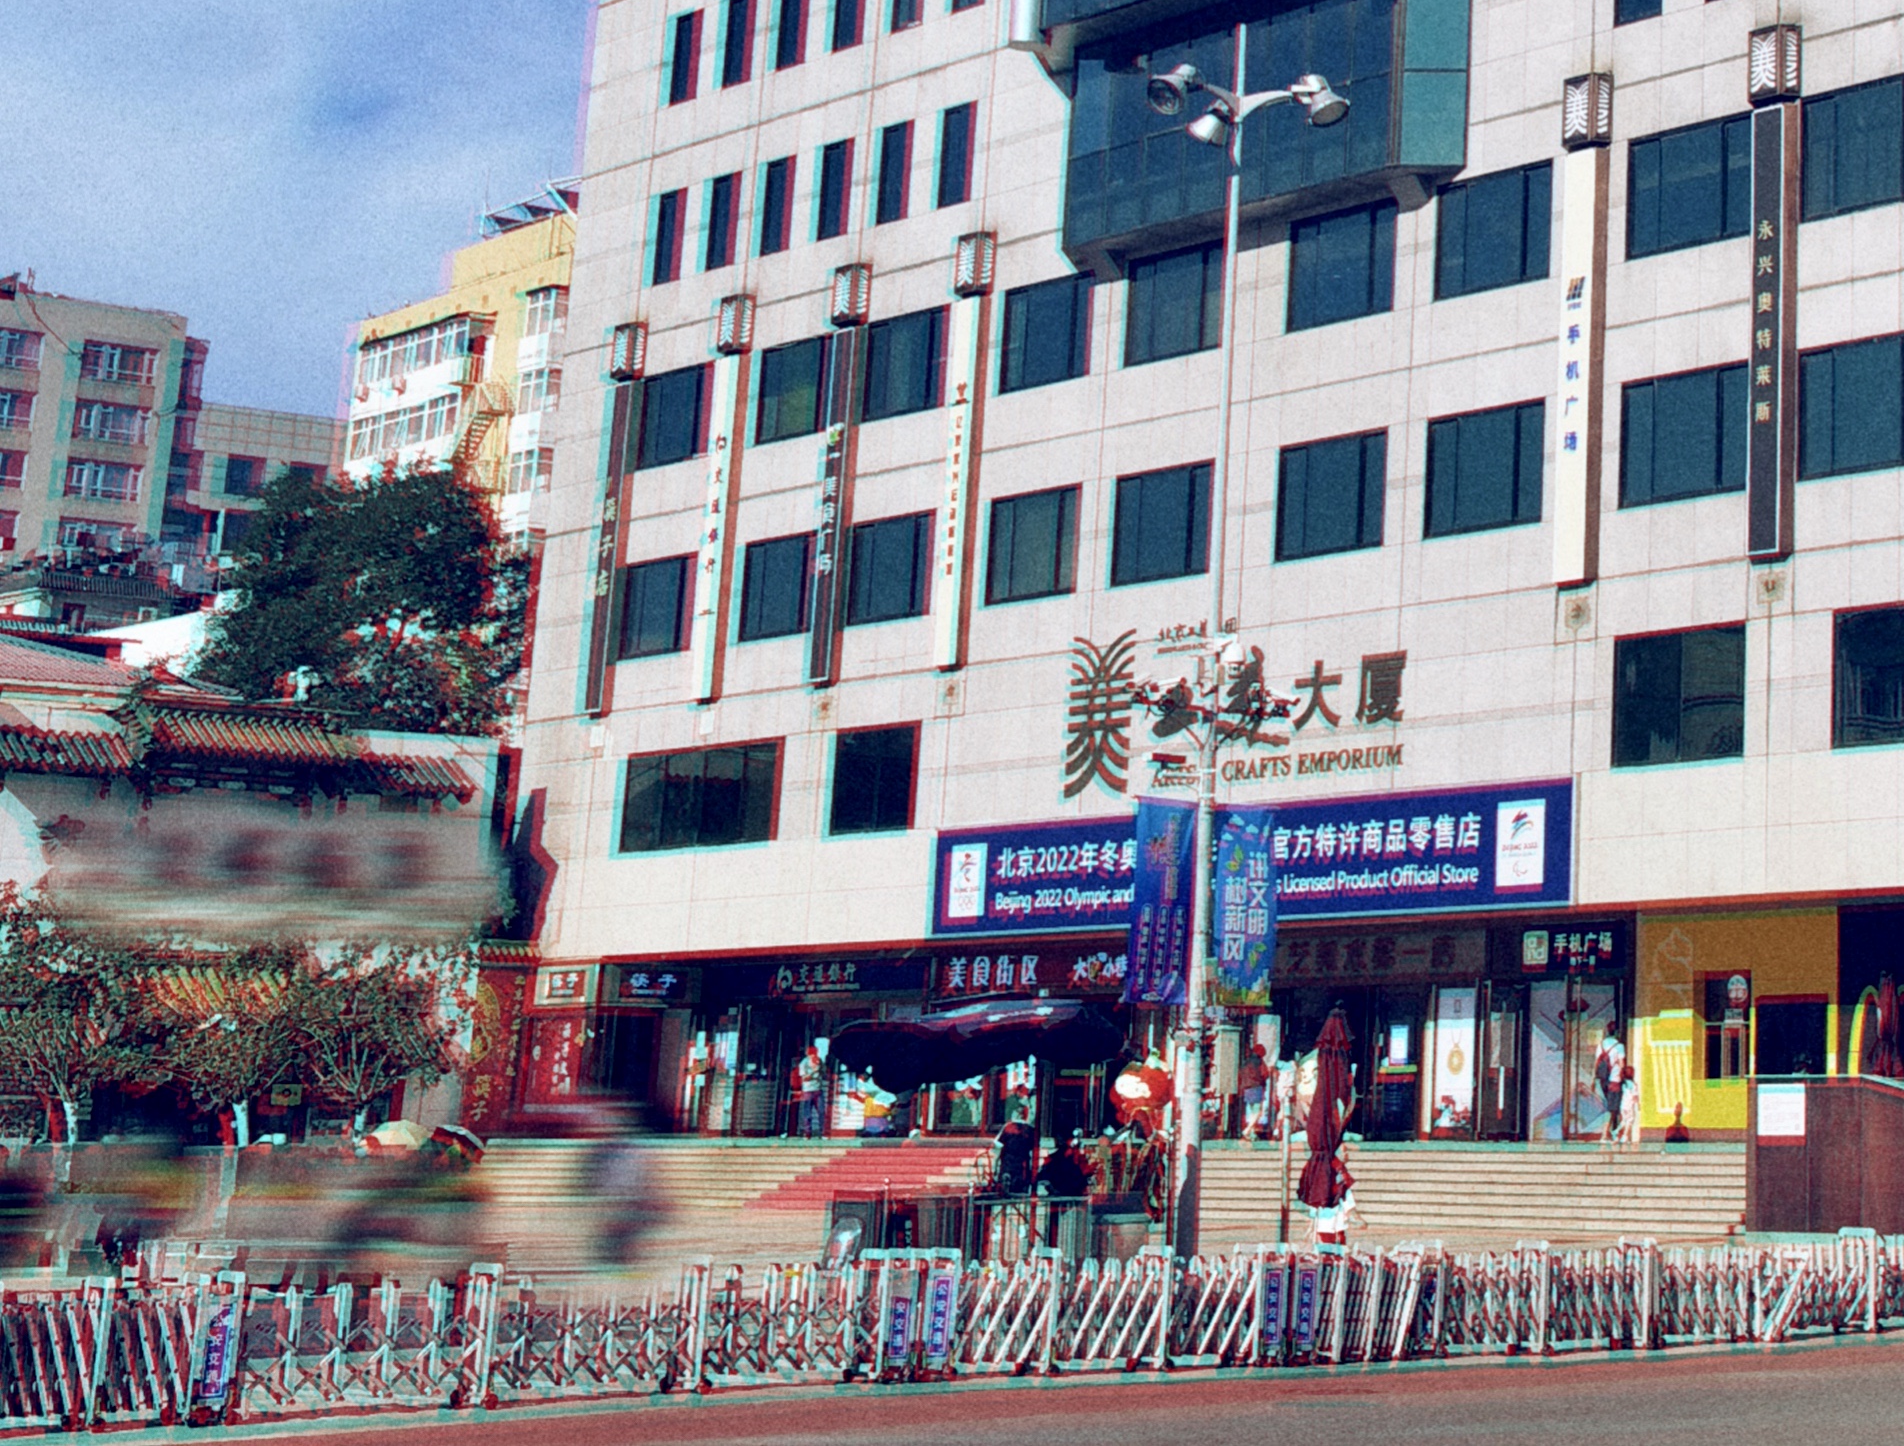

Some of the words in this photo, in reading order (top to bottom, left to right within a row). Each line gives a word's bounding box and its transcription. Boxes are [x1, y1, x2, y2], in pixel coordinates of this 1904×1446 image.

[1755, 218, 1775, 423] 永兴奥特莱斯
[1563, 323, 1581, 452] 手机广场
[1221, 756, 1292, 783] CRAFTS
[1297, 745, 1404, 775] EMPORIUM
[995, 891, 1033, 915] Beijing
[1034, 889, 1063, 908] 2022
[1064, 886, 1111, 911] Olympic
[1112, 883, 1135, 903] and
[1283, 870, 1336, 894] Licensed
[1337, 867, 1388, 890] Product
[1390, 864, 1441, 887] Official
[1442, 862, 1479, 884] Store
[1223, 875, 1247, 961] 树新风
[1247, 851, 1269, 935] 讲文明
[948, 955, 1039, 988] 美食街区
[1553, 931, 1613, 954] 手机广场
